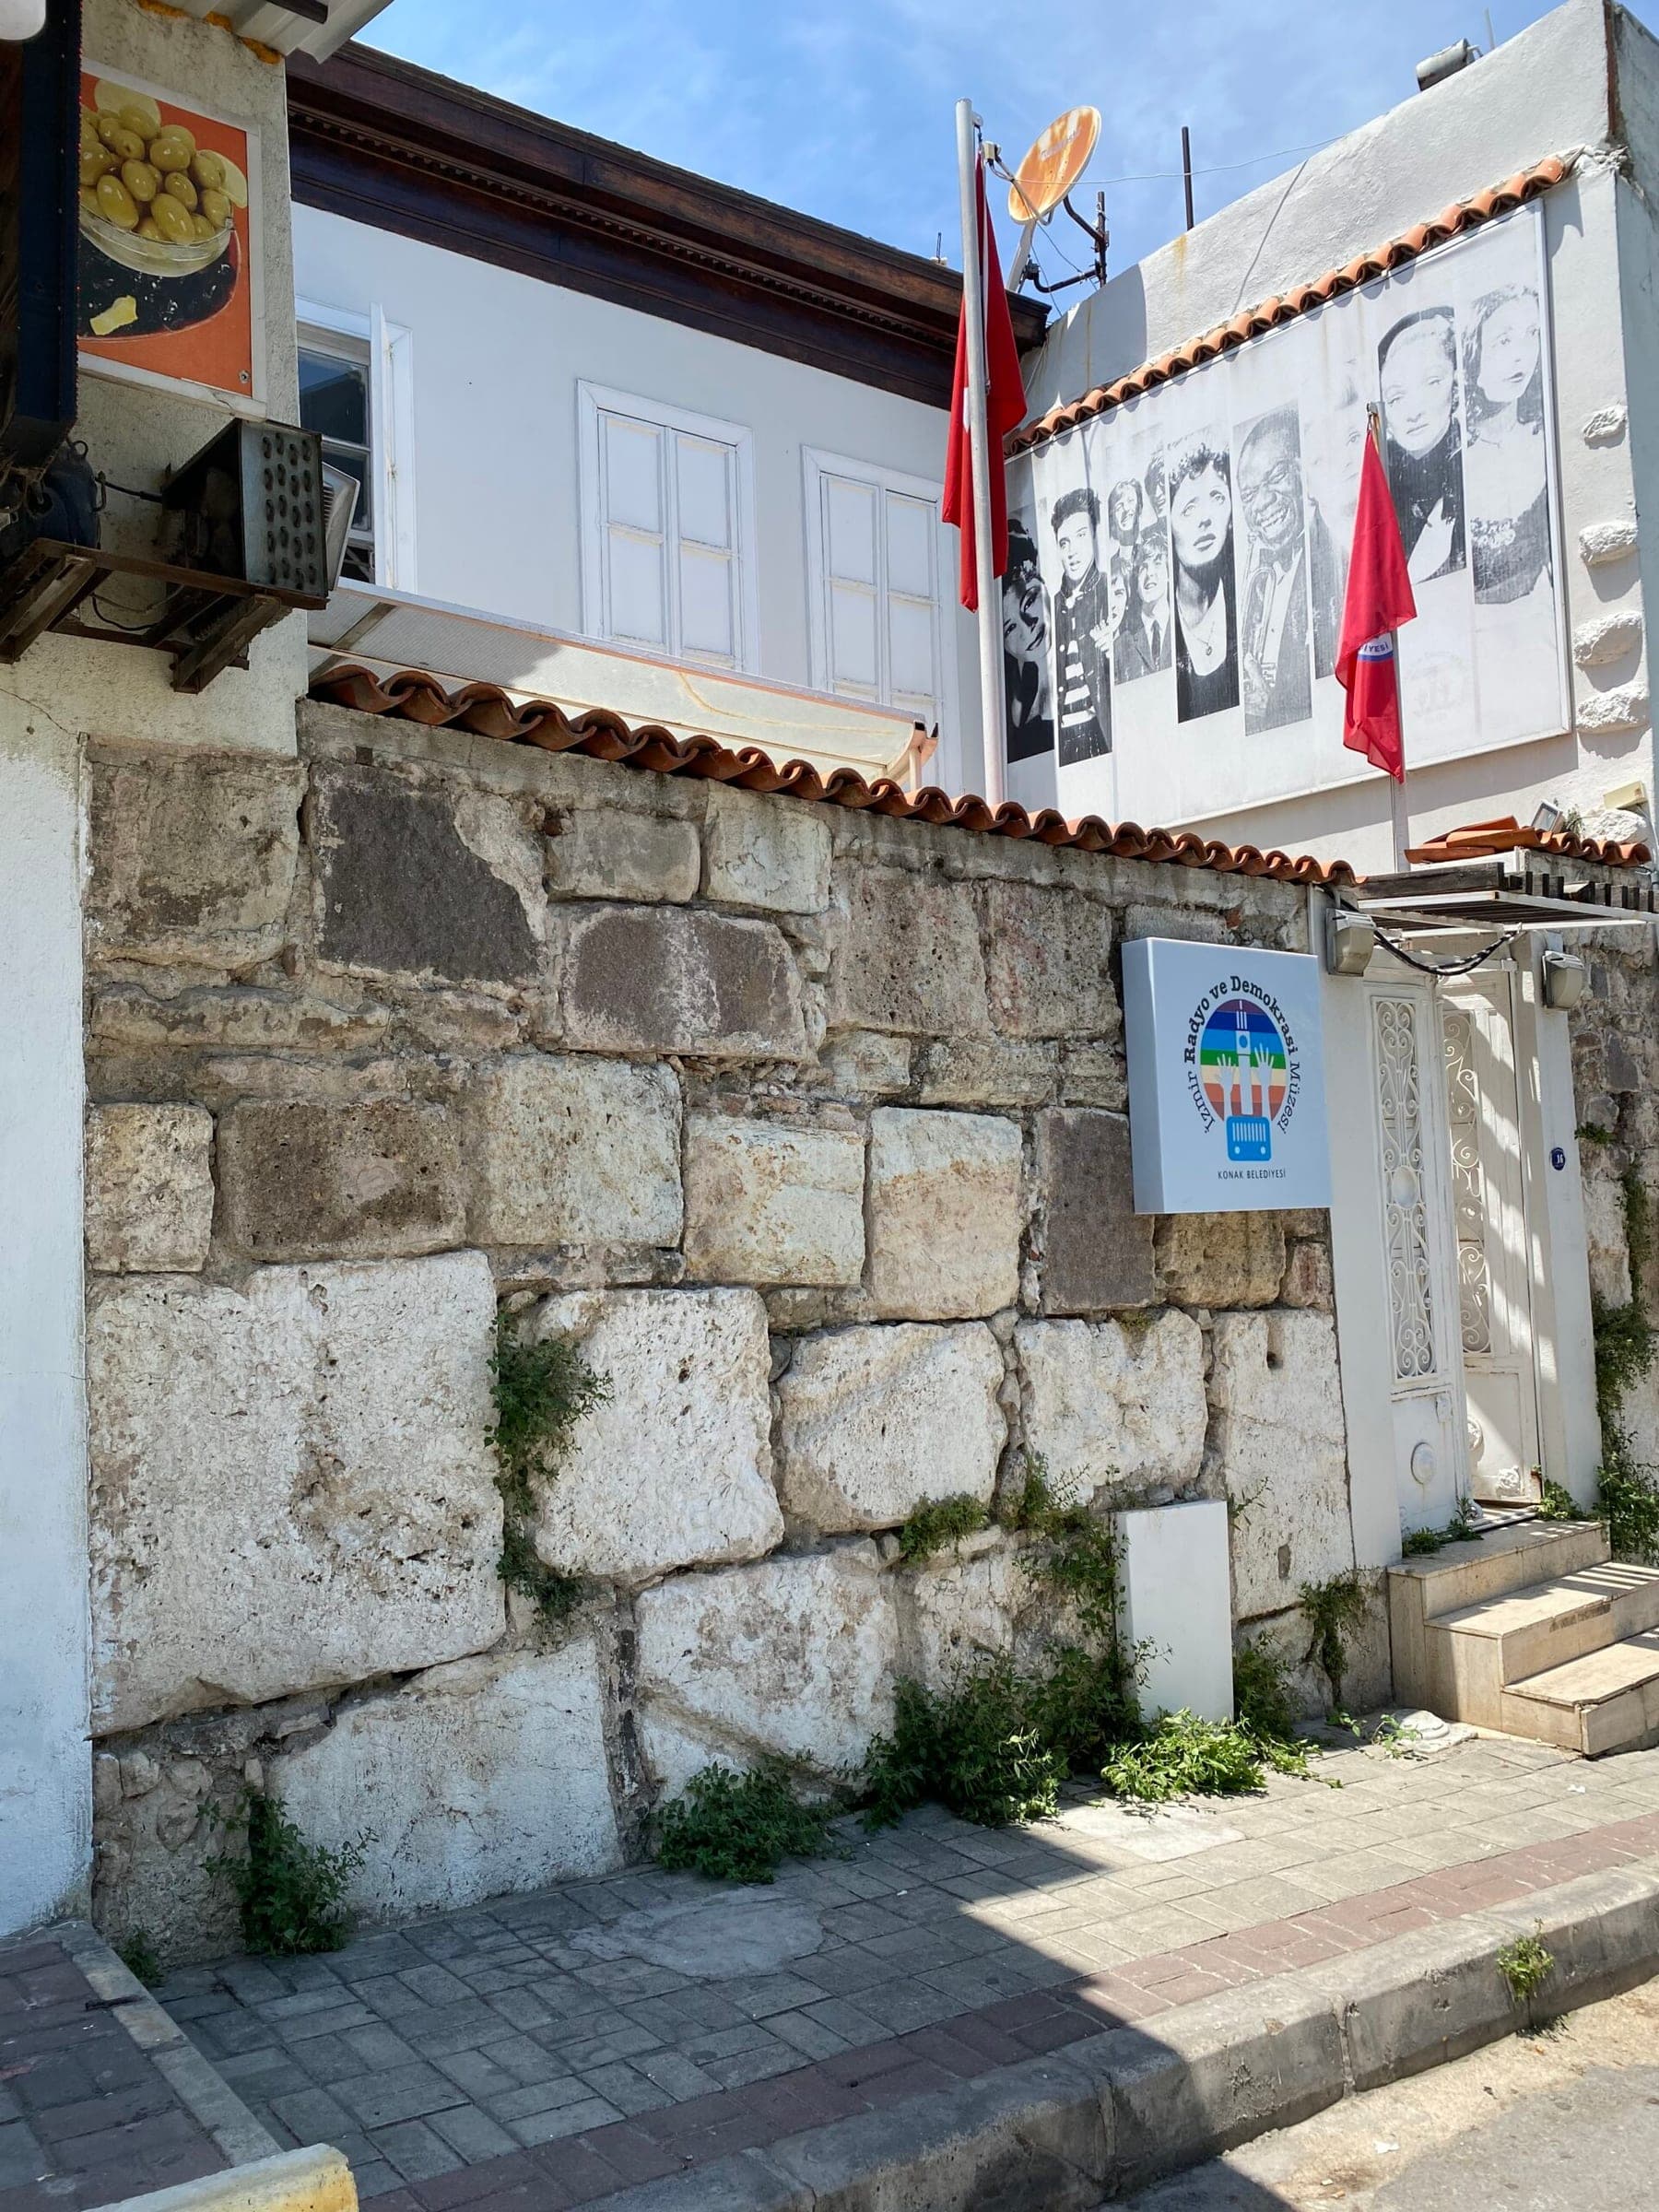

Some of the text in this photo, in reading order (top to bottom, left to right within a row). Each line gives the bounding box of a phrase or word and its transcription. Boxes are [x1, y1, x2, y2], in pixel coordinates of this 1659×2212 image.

[1184, 975, 1300, 1135] İzmir Radyo ve Demokrasi Müzesi
[1218, 1171, 1243, 1180] KONAK
